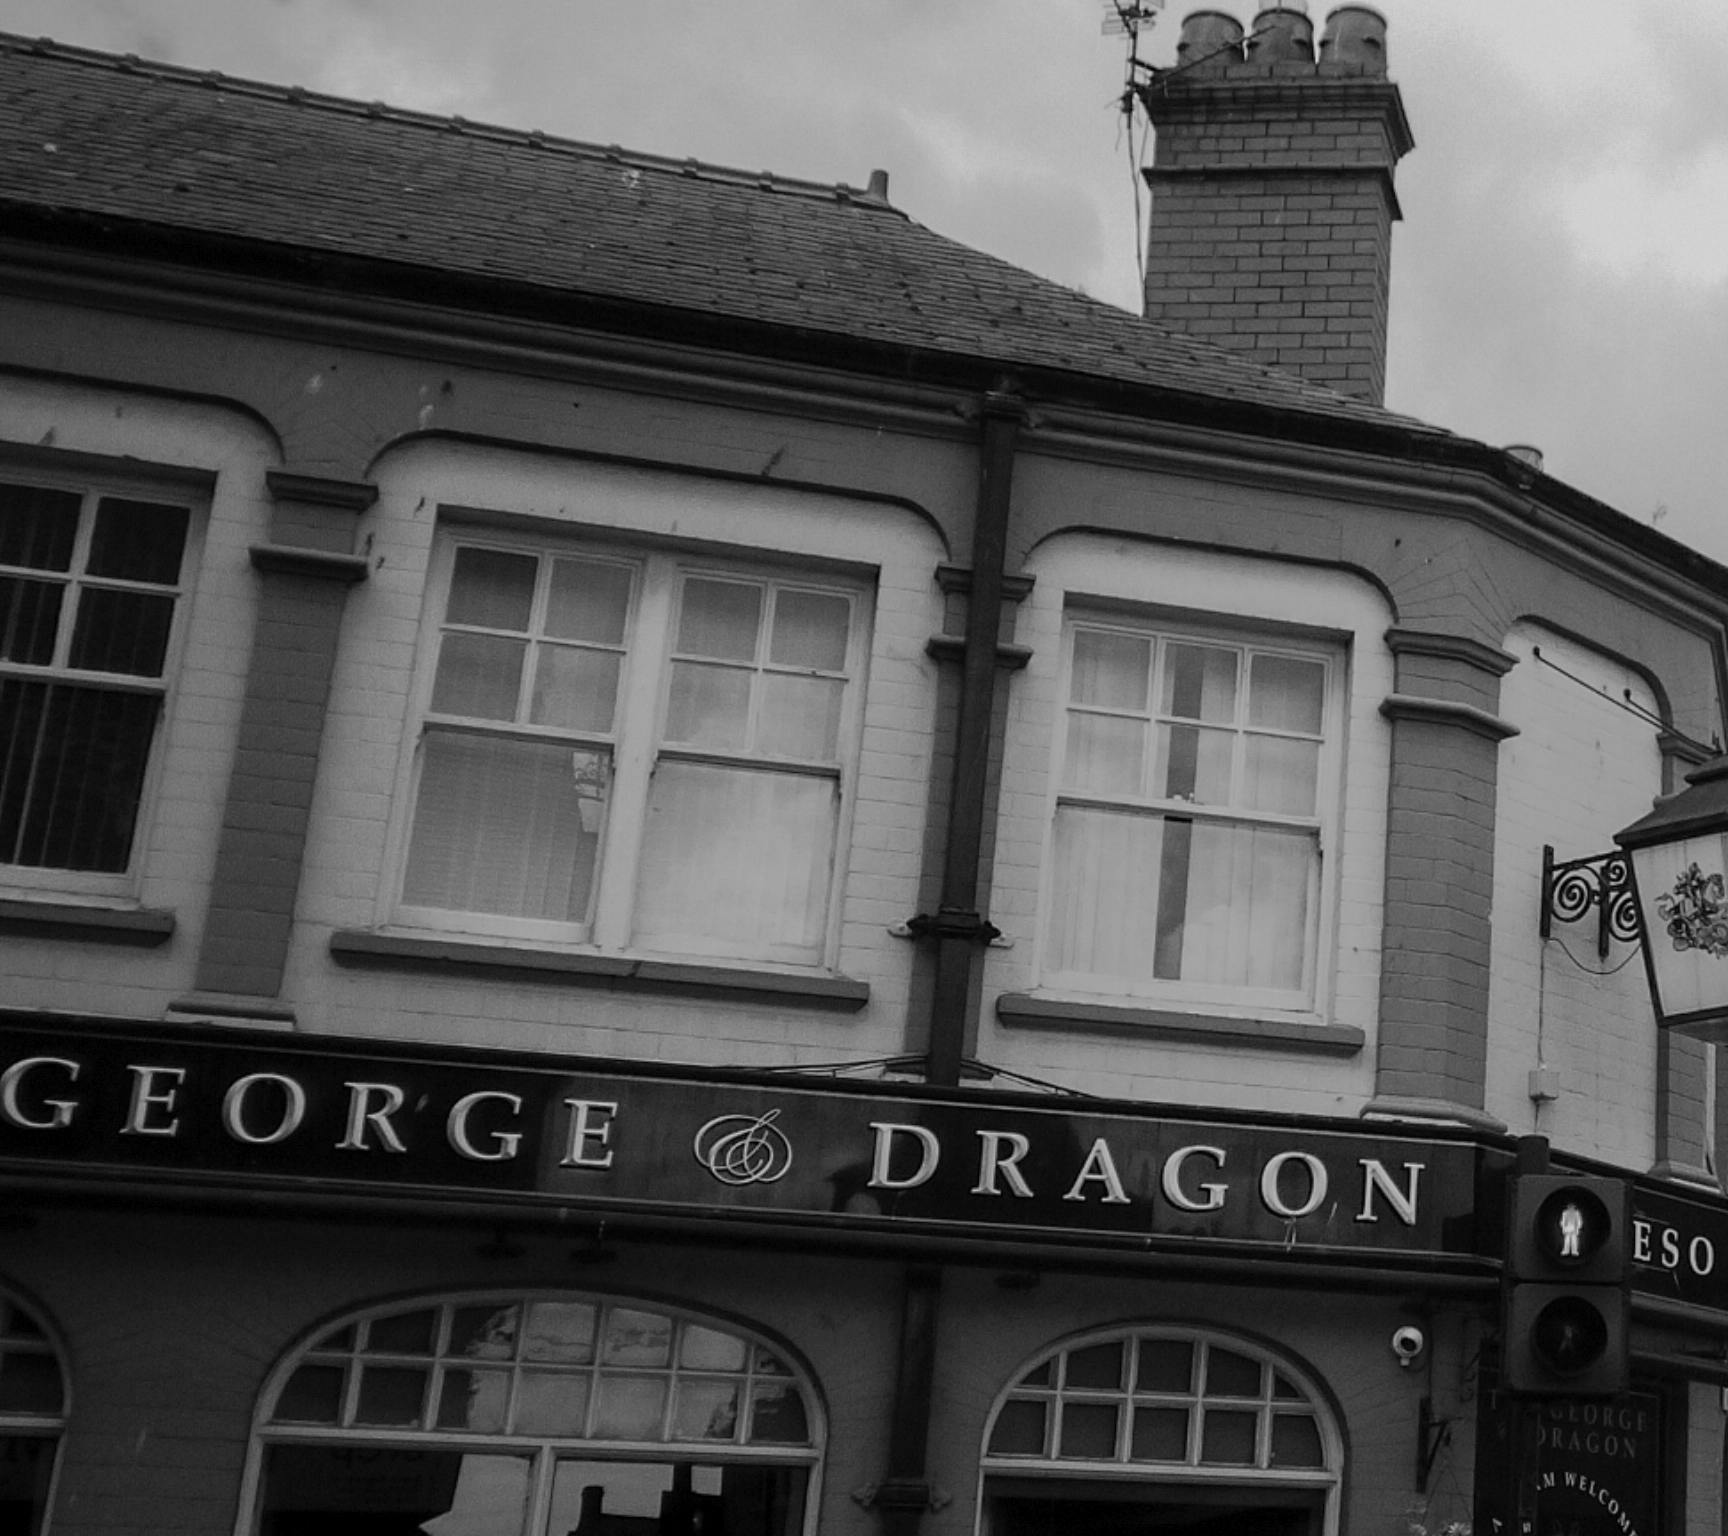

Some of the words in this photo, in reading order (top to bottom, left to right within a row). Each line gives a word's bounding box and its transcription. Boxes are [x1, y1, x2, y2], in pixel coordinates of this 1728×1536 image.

[0, 1056, 621, 1170] GEORGE
[866, 1120, 1426, 1228] DRAGON
[1632, 1219, 1715, 1277] ESO
